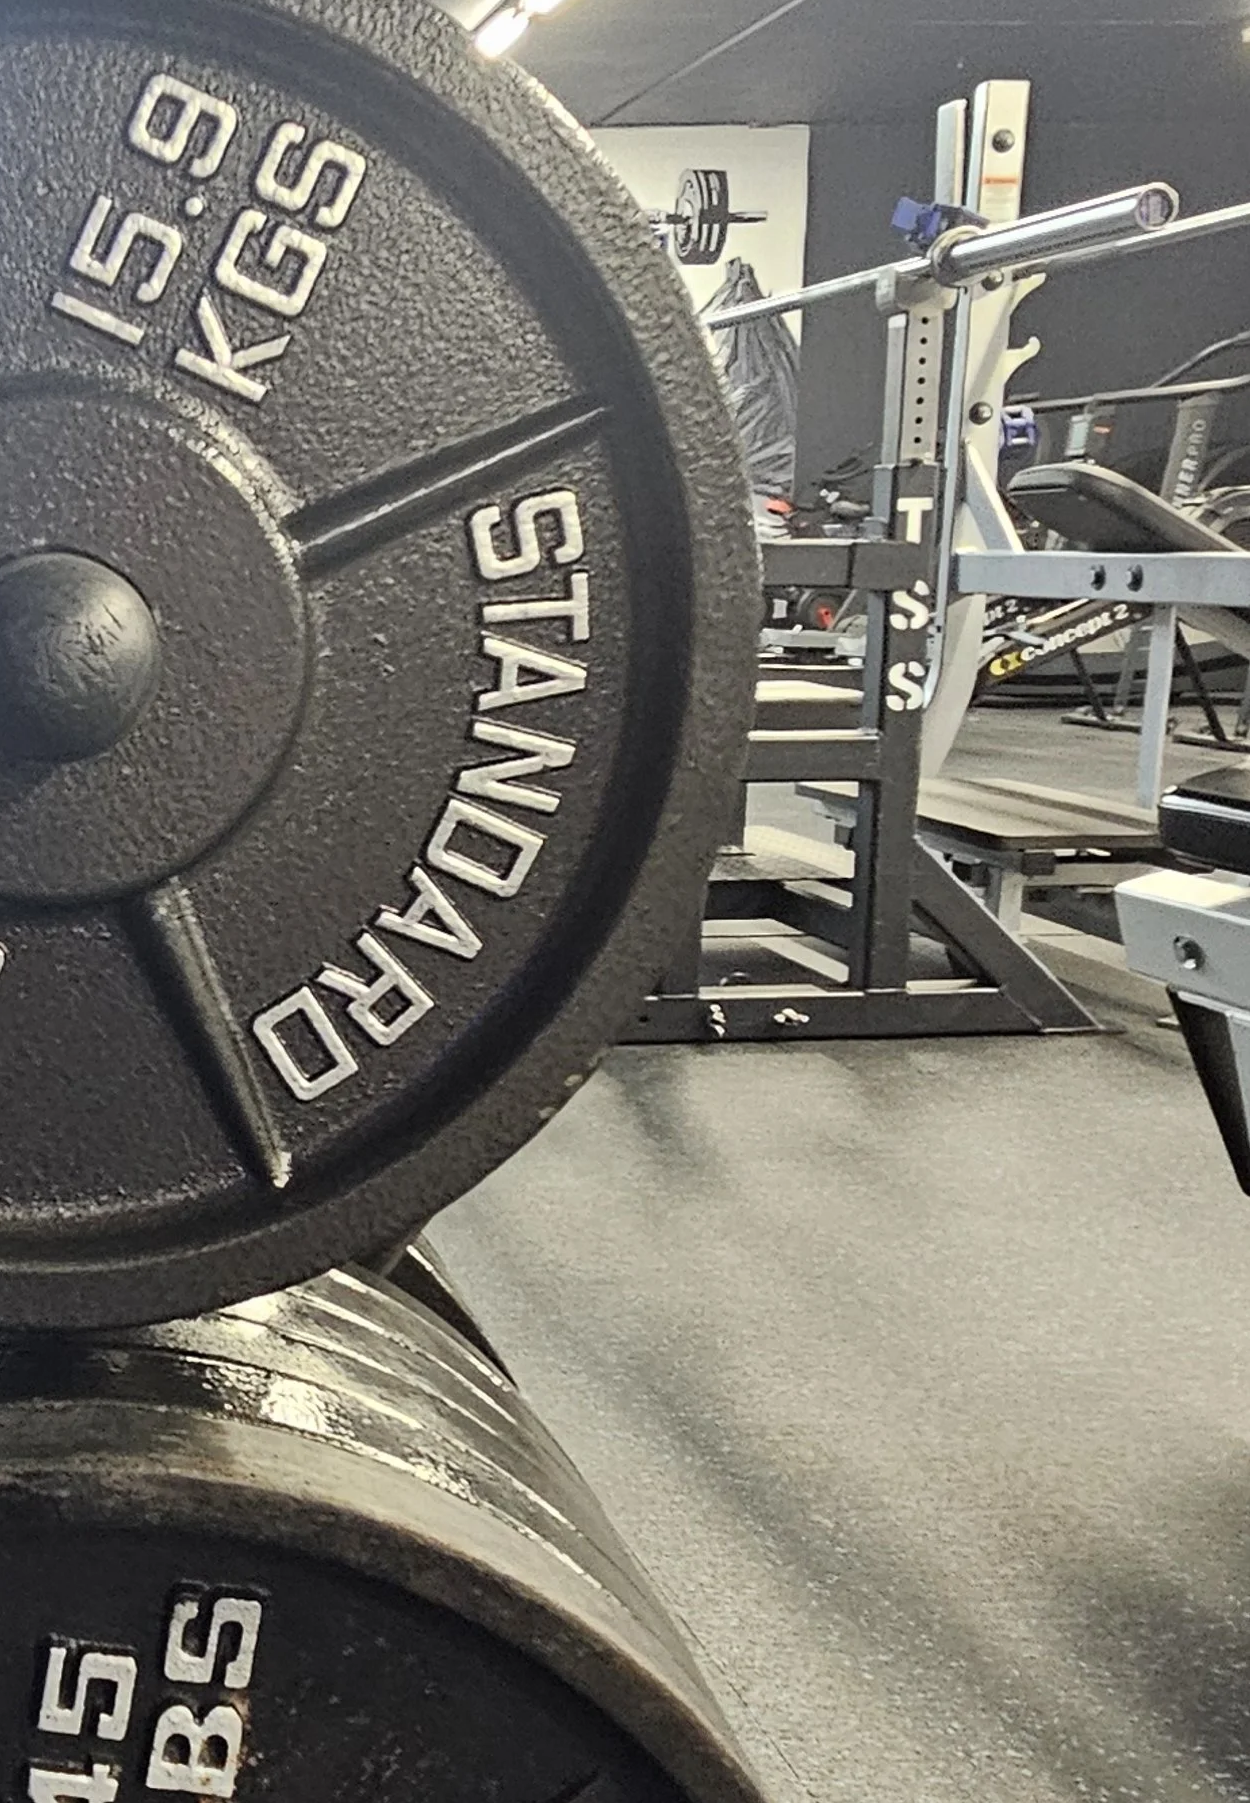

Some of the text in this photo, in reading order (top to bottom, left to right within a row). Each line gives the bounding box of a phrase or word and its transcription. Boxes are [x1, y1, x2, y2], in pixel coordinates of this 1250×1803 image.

[49, 72, 236, 346] 15.9
[172, 122, 367, 403] KGS
[249, 488, 590, 1104] STANDARD
